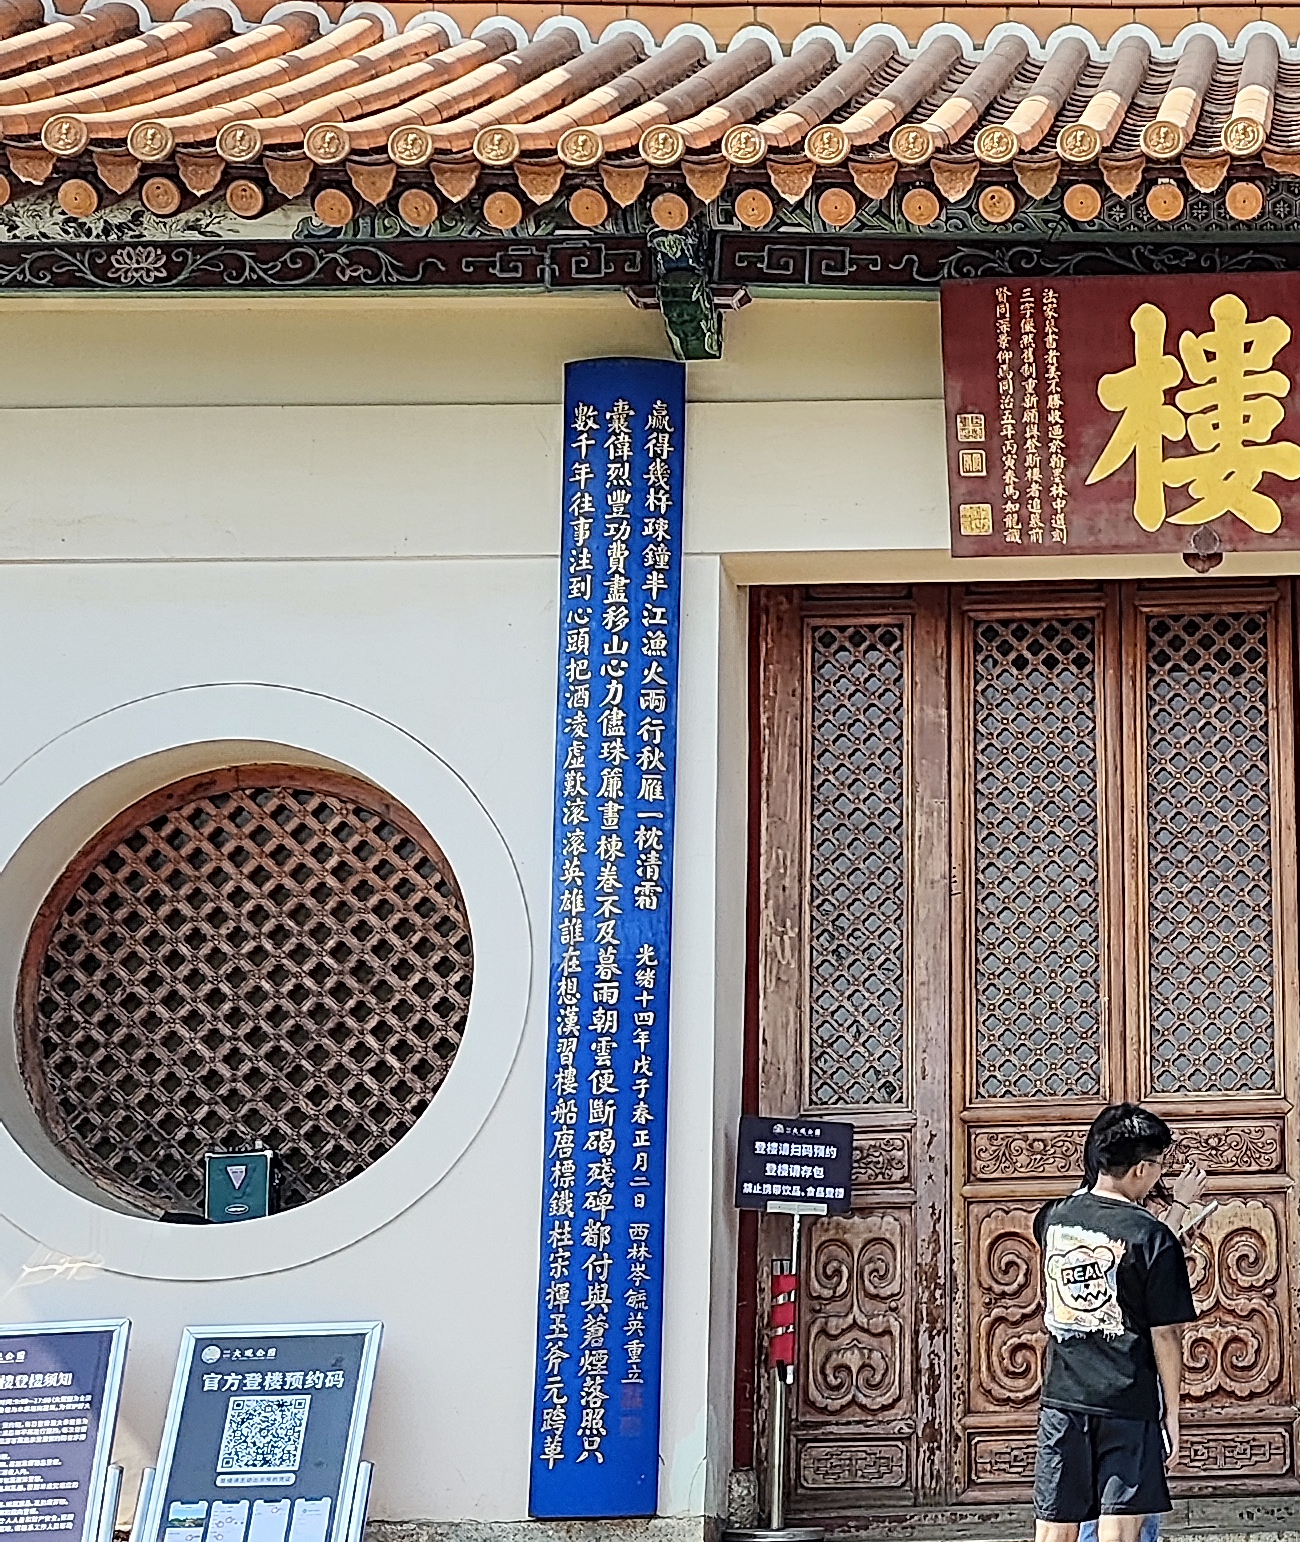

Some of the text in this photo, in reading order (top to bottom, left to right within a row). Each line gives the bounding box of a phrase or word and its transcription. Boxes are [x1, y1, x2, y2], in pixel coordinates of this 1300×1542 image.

[754, 1141, 838, 1159] 登楼请扫码预约
[764, 1163, 825, 1179] 登楼请存包
[1063, 1262, 1103, 1284] REAL
[202, 1370, 345, 1392] 官方登楼预约码
